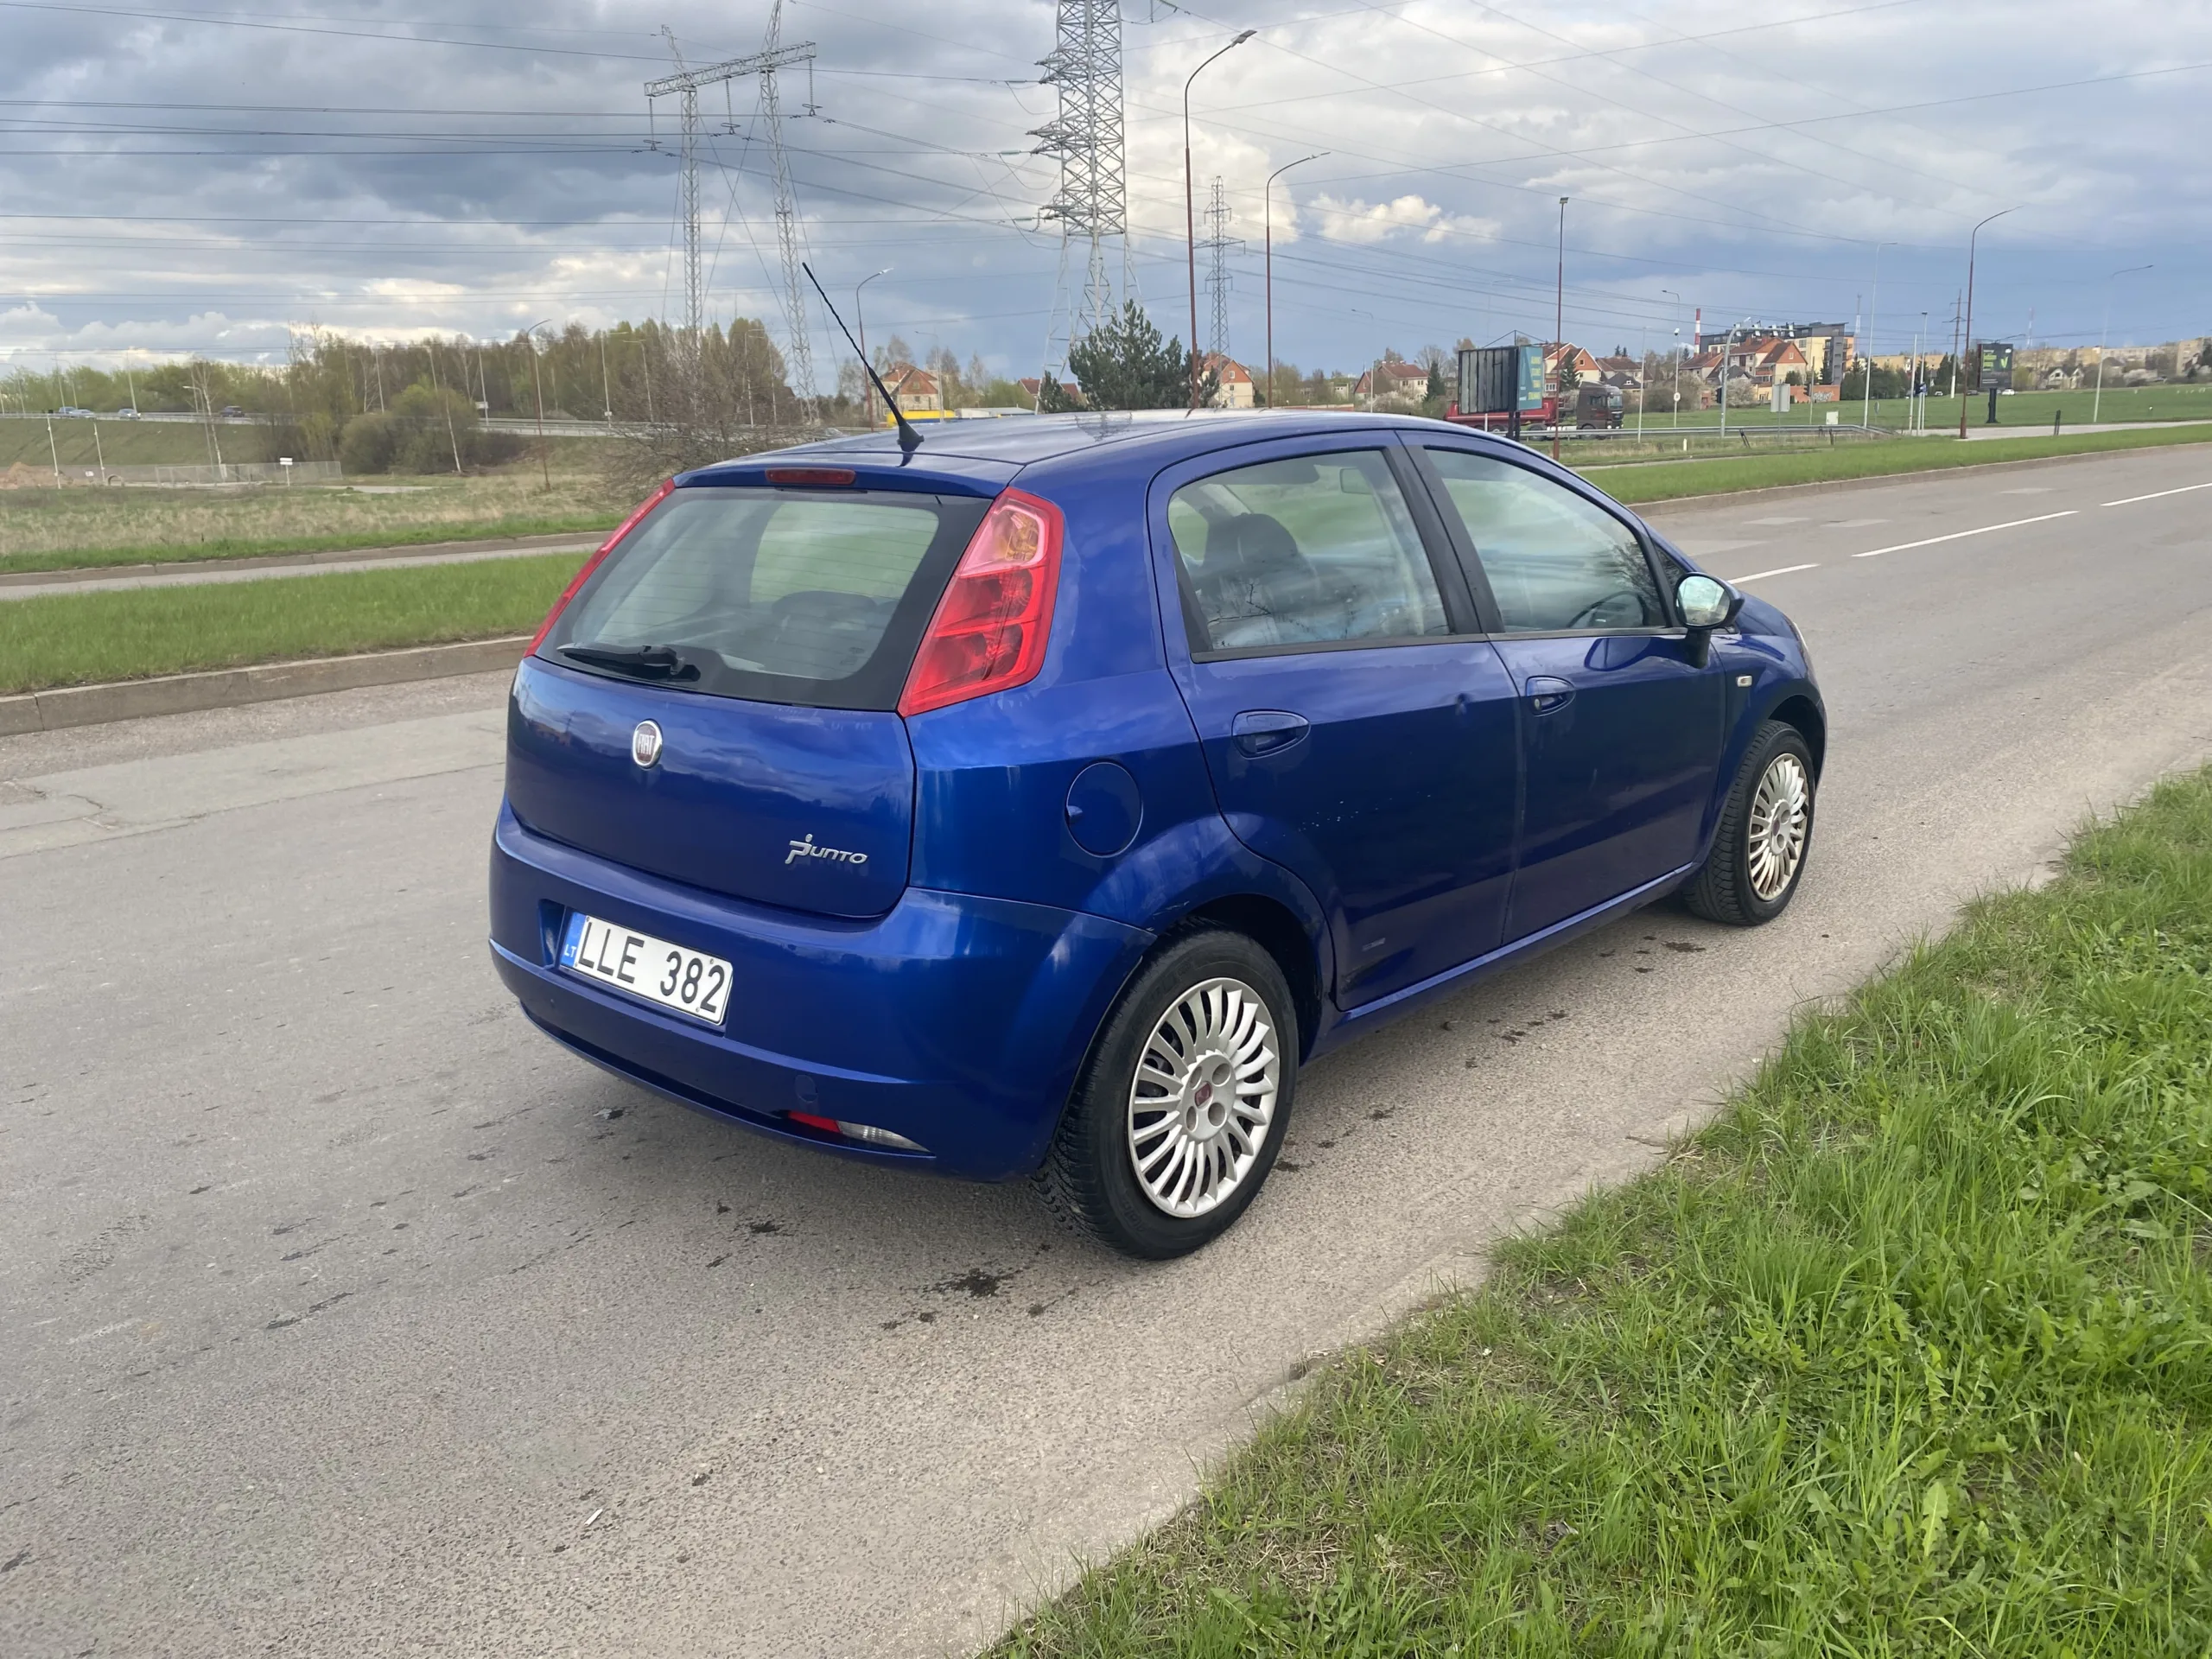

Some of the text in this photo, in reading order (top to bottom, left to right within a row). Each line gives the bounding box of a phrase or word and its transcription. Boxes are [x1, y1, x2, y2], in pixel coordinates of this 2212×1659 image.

[637, 734, 655, 755] FIAT
[563, 944, 577, 958] LT
[578, 921, 725, 1014] LLE 382
